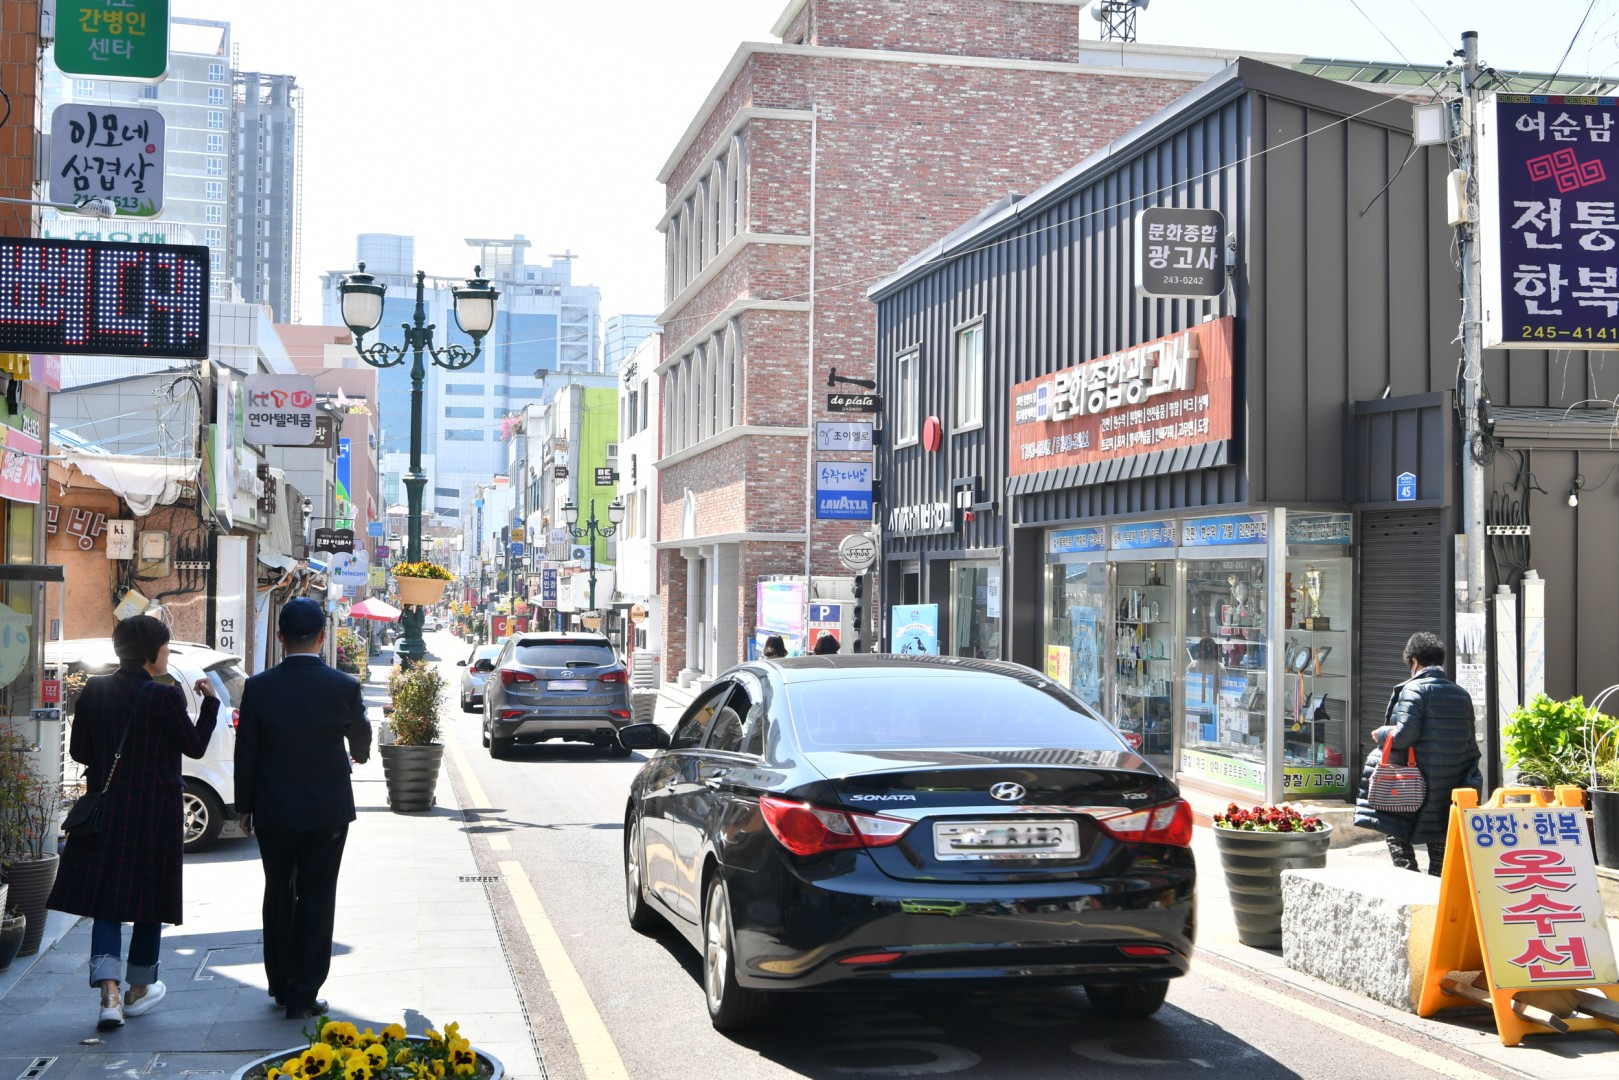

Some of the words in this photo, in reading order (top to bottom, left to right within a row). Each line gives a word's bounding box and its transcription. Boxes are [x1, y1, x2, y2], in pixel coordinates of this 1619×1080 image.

[79, 8, 146, 36] 간병인
[88, 38, 135, 61] 센타
[69, 111, 149, 149] 이모네
[1515, 111, 1614, 143] 여순남
[61, 153, 155, 194] 삼겹살
[1148, 223, 1218, 243] 문화종합
[1511, 197, 1619, 252] 전통
[1148, 245, 1218, 270] 광고사
[1163, 276, 1204, 285] 243-0242
[1513, 263, 1619, 318] 한복
[1522, 325, 1618, 340] 245-4141
[1052, 332, 1199, 422] 문화종합광고사
[830, 395, 845, 404] de
[845, 395, 873, 406] plata
[248, 413, 312, 428] 연아텔레콤
[822, 467, 867, 484] 수작다방
[1401, 486, 1411, 498] 45
[820, 495, 868, 510] LAVAZZA
[819, 605, 830, 621] P
[1313, 773, 1345, 788] 고무인
[850, 794, 916, 802] SONATA
[1122, 792, 1148, 800] Y20
[1493, 848, 1596, 982] 옷수선
